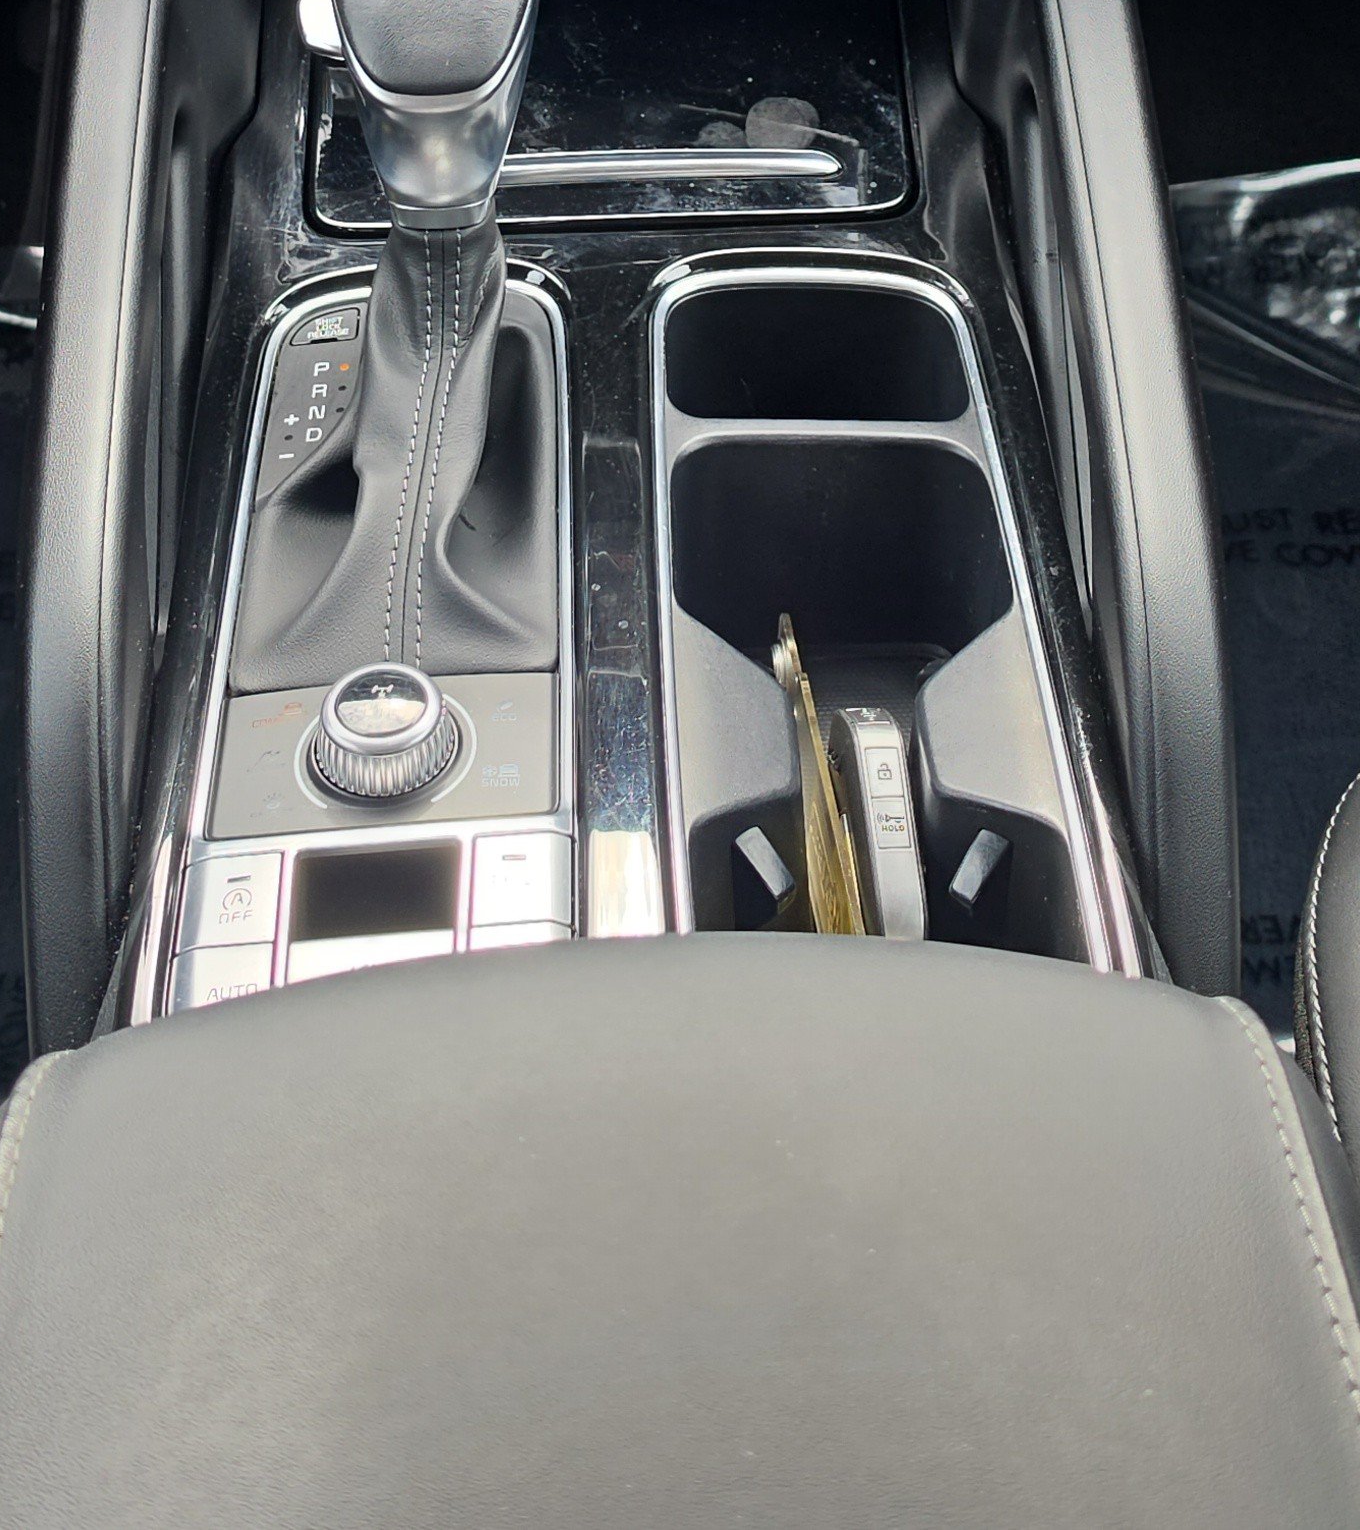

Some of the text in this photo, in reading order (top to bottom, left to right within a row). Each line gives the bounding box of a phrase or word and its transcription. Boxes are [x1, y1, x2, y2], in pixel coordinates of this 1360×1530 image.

[313, 362, 330, 377] P
[311, 384, 328, 398] R
[308, 404, 326, 420] N
[305, 427, 323, 442] D
[481, 777, 520, 787] SNOW
[881, 824, 905, 832] HOLD
